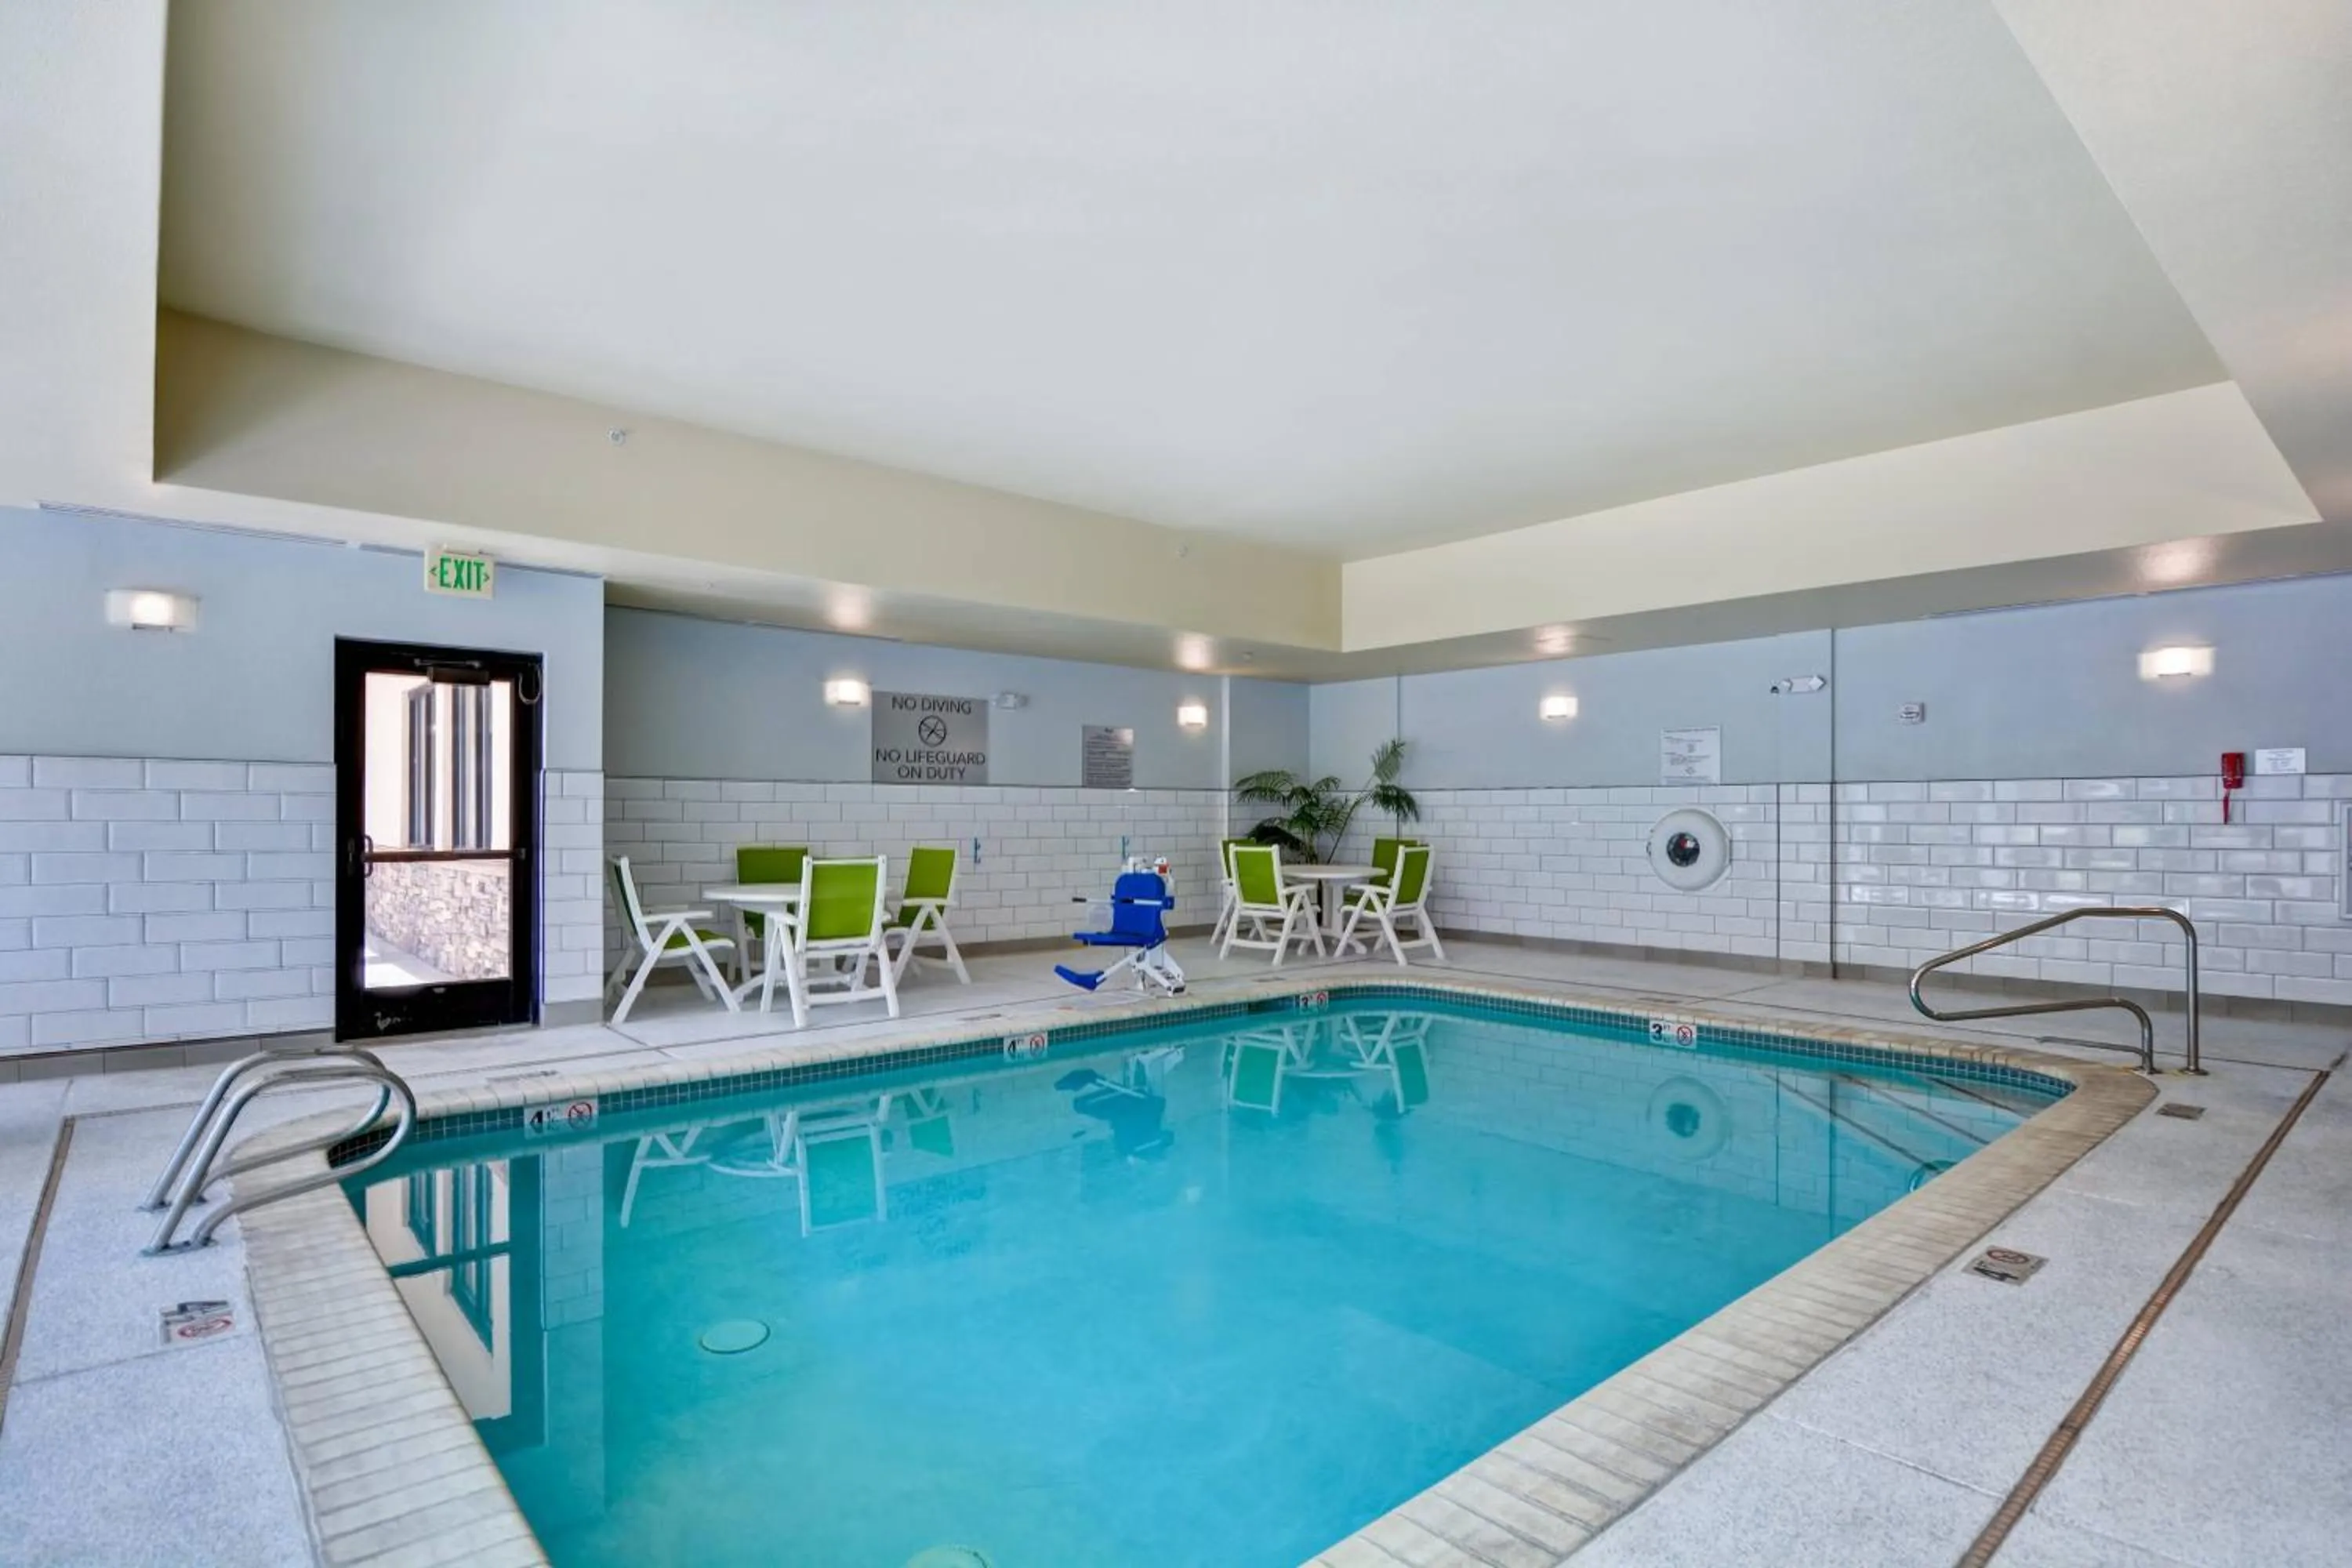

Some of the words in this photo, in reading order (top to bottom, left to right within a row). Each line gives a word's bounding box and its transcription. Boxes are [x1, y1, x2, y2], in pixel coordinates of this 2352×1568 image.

[440, 557, 485, 591] EXIT
[891, 696, 916, 711] NO
[921, 697, 971, 715] DIVING
[876, 748, 901, 763] NO
[906, 750, 985, 765] LIFEGUARD
[898, 764, 921, 779] ON
[927, 767, 966, 780] DUTY
